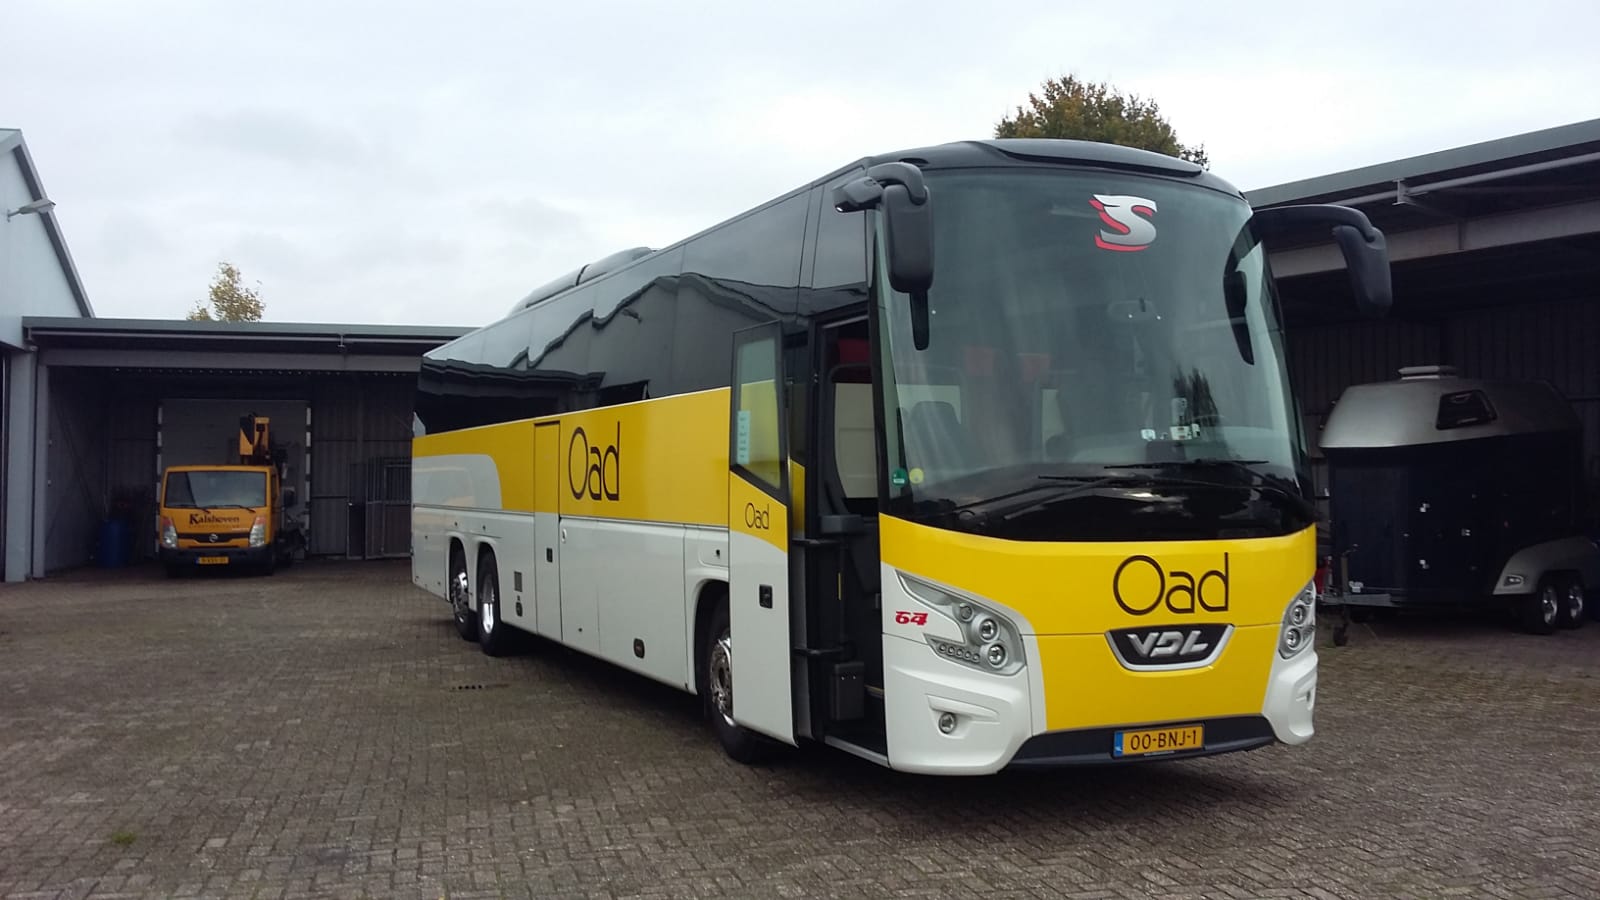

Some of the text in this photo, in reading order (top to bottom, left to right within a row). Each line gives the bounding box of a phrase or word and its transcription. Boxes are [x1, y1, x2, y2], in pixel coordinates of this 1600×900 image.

[568, 420, 621, 501] Oad
[745, 502, 770, 530] Oad
[1113, 552, 1230, 616] Oad
[895, 610, 929, 626] 64
[1127, 630, 1209, 658] VDL
[1130, 729, 1197, 751] 00-BNJ-1
